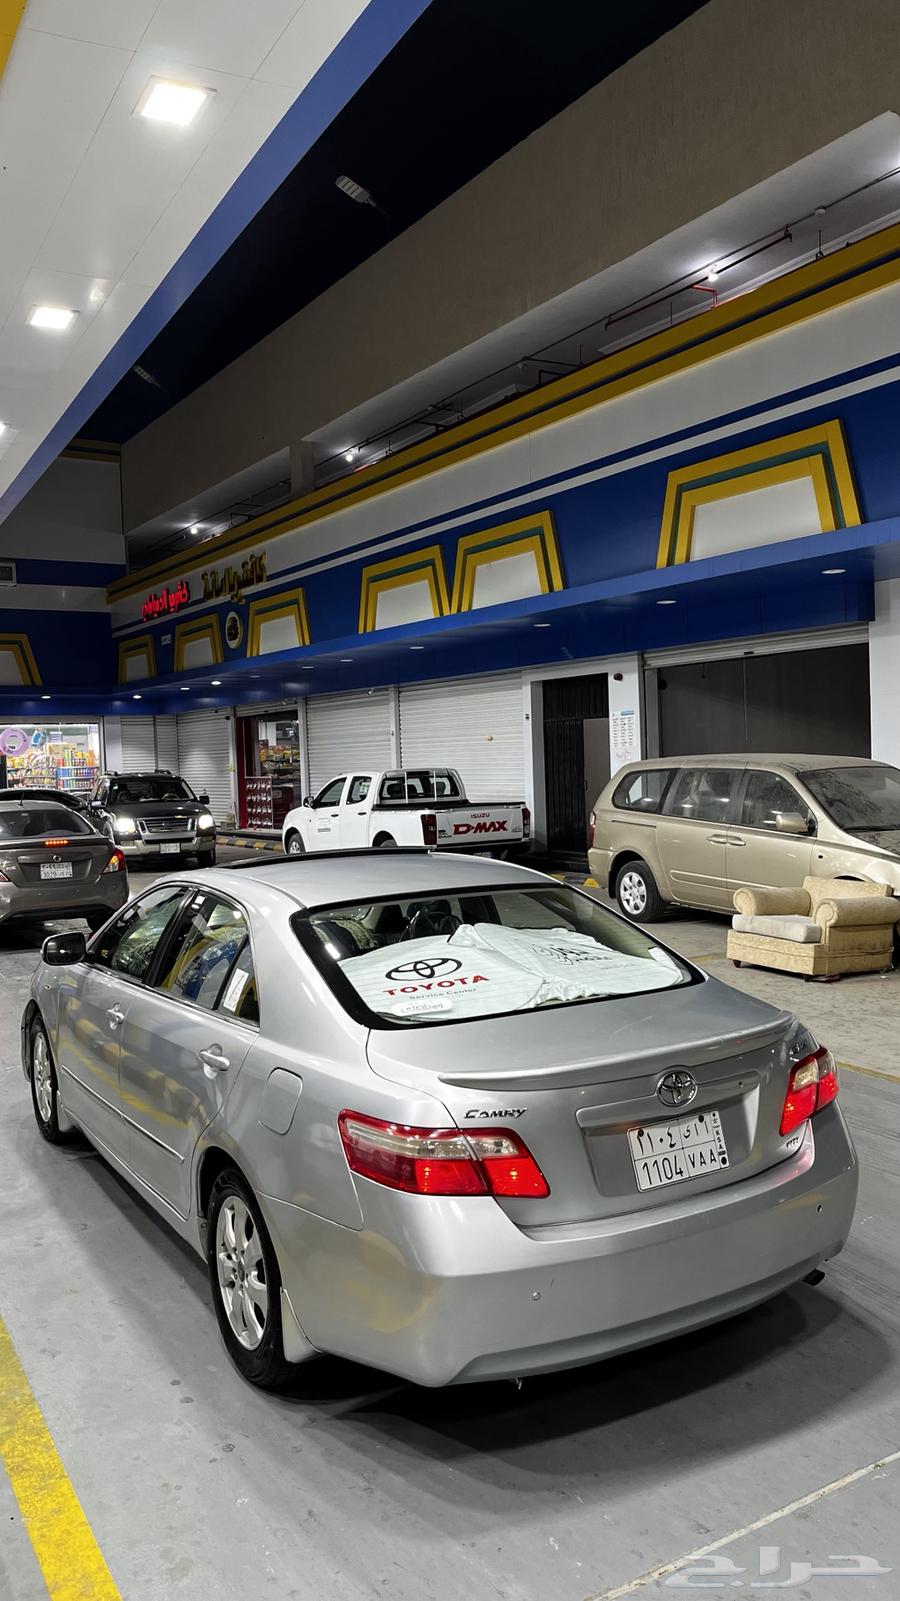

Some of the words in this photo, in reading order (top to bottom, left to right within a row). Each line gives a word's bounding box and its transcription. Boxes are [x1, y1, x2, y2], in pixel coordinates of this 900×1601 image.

[383, 975, 490, 996] TOYOTA
[464, 1107, 528, 1119] CAMRY
[642, 1155, 683, 1185] 1104
[688, 1149, 717, 1168] VAA
